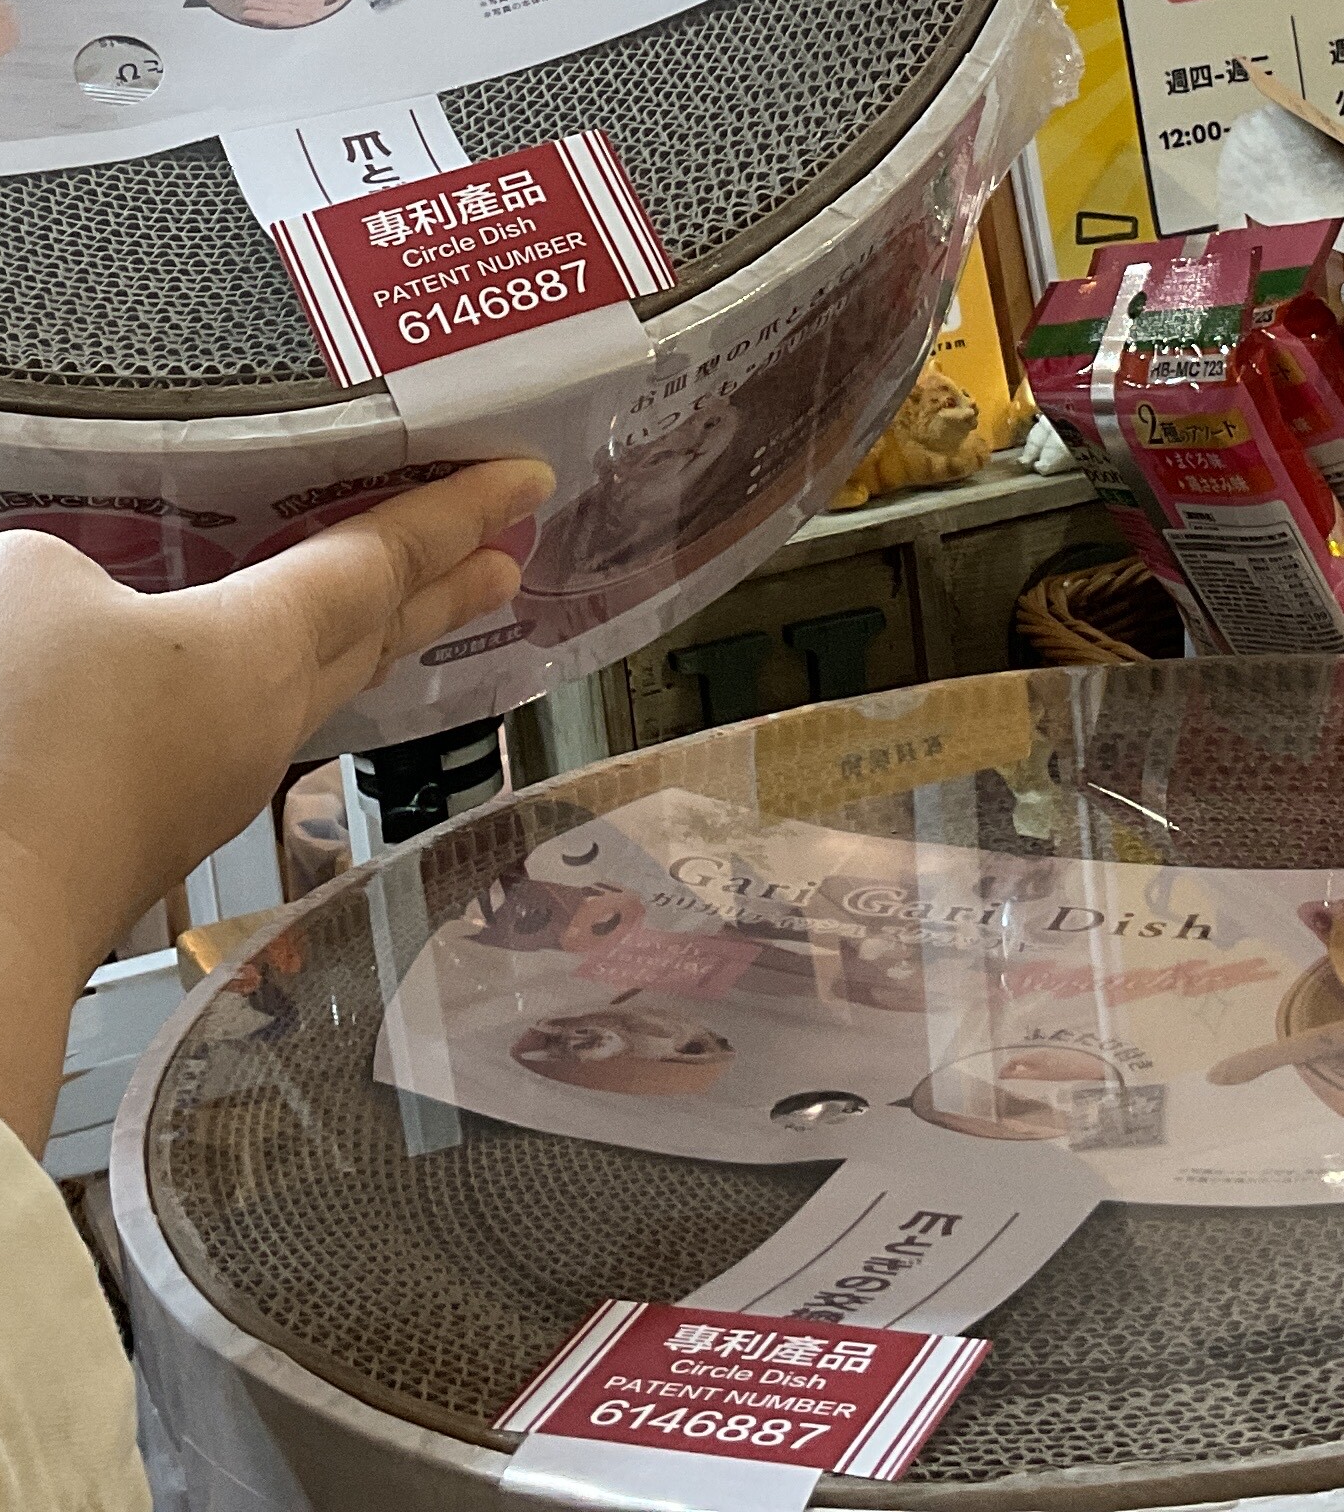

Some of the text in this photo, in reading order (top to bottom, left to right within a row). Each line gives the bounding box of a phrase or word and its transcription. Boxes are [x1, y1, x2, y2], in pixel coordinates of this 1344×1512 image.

[341, 130, 402, 192] 爪と
[361, 169, 548, 248] 專利產品
[401, 216, 537, 269] Circle Dish
[373, 231, 588, 309] PATENT NUMBER
[397, 258, 591, 345] 6146887
[1203, 359, 1225, 377] 723
[668, 855, 818, 905] Gari
[842, 886, 1004, 926] Gari
[1042, 905, 1213, 941] Dish
[662, 1322, 879, 1374] 專利產品
[669, 1358, 827, 1391] Circle Dish
[603, 1375, 858, 1420] PATENT NUMBER
[589, 1399, 832, 1451] 6146887
